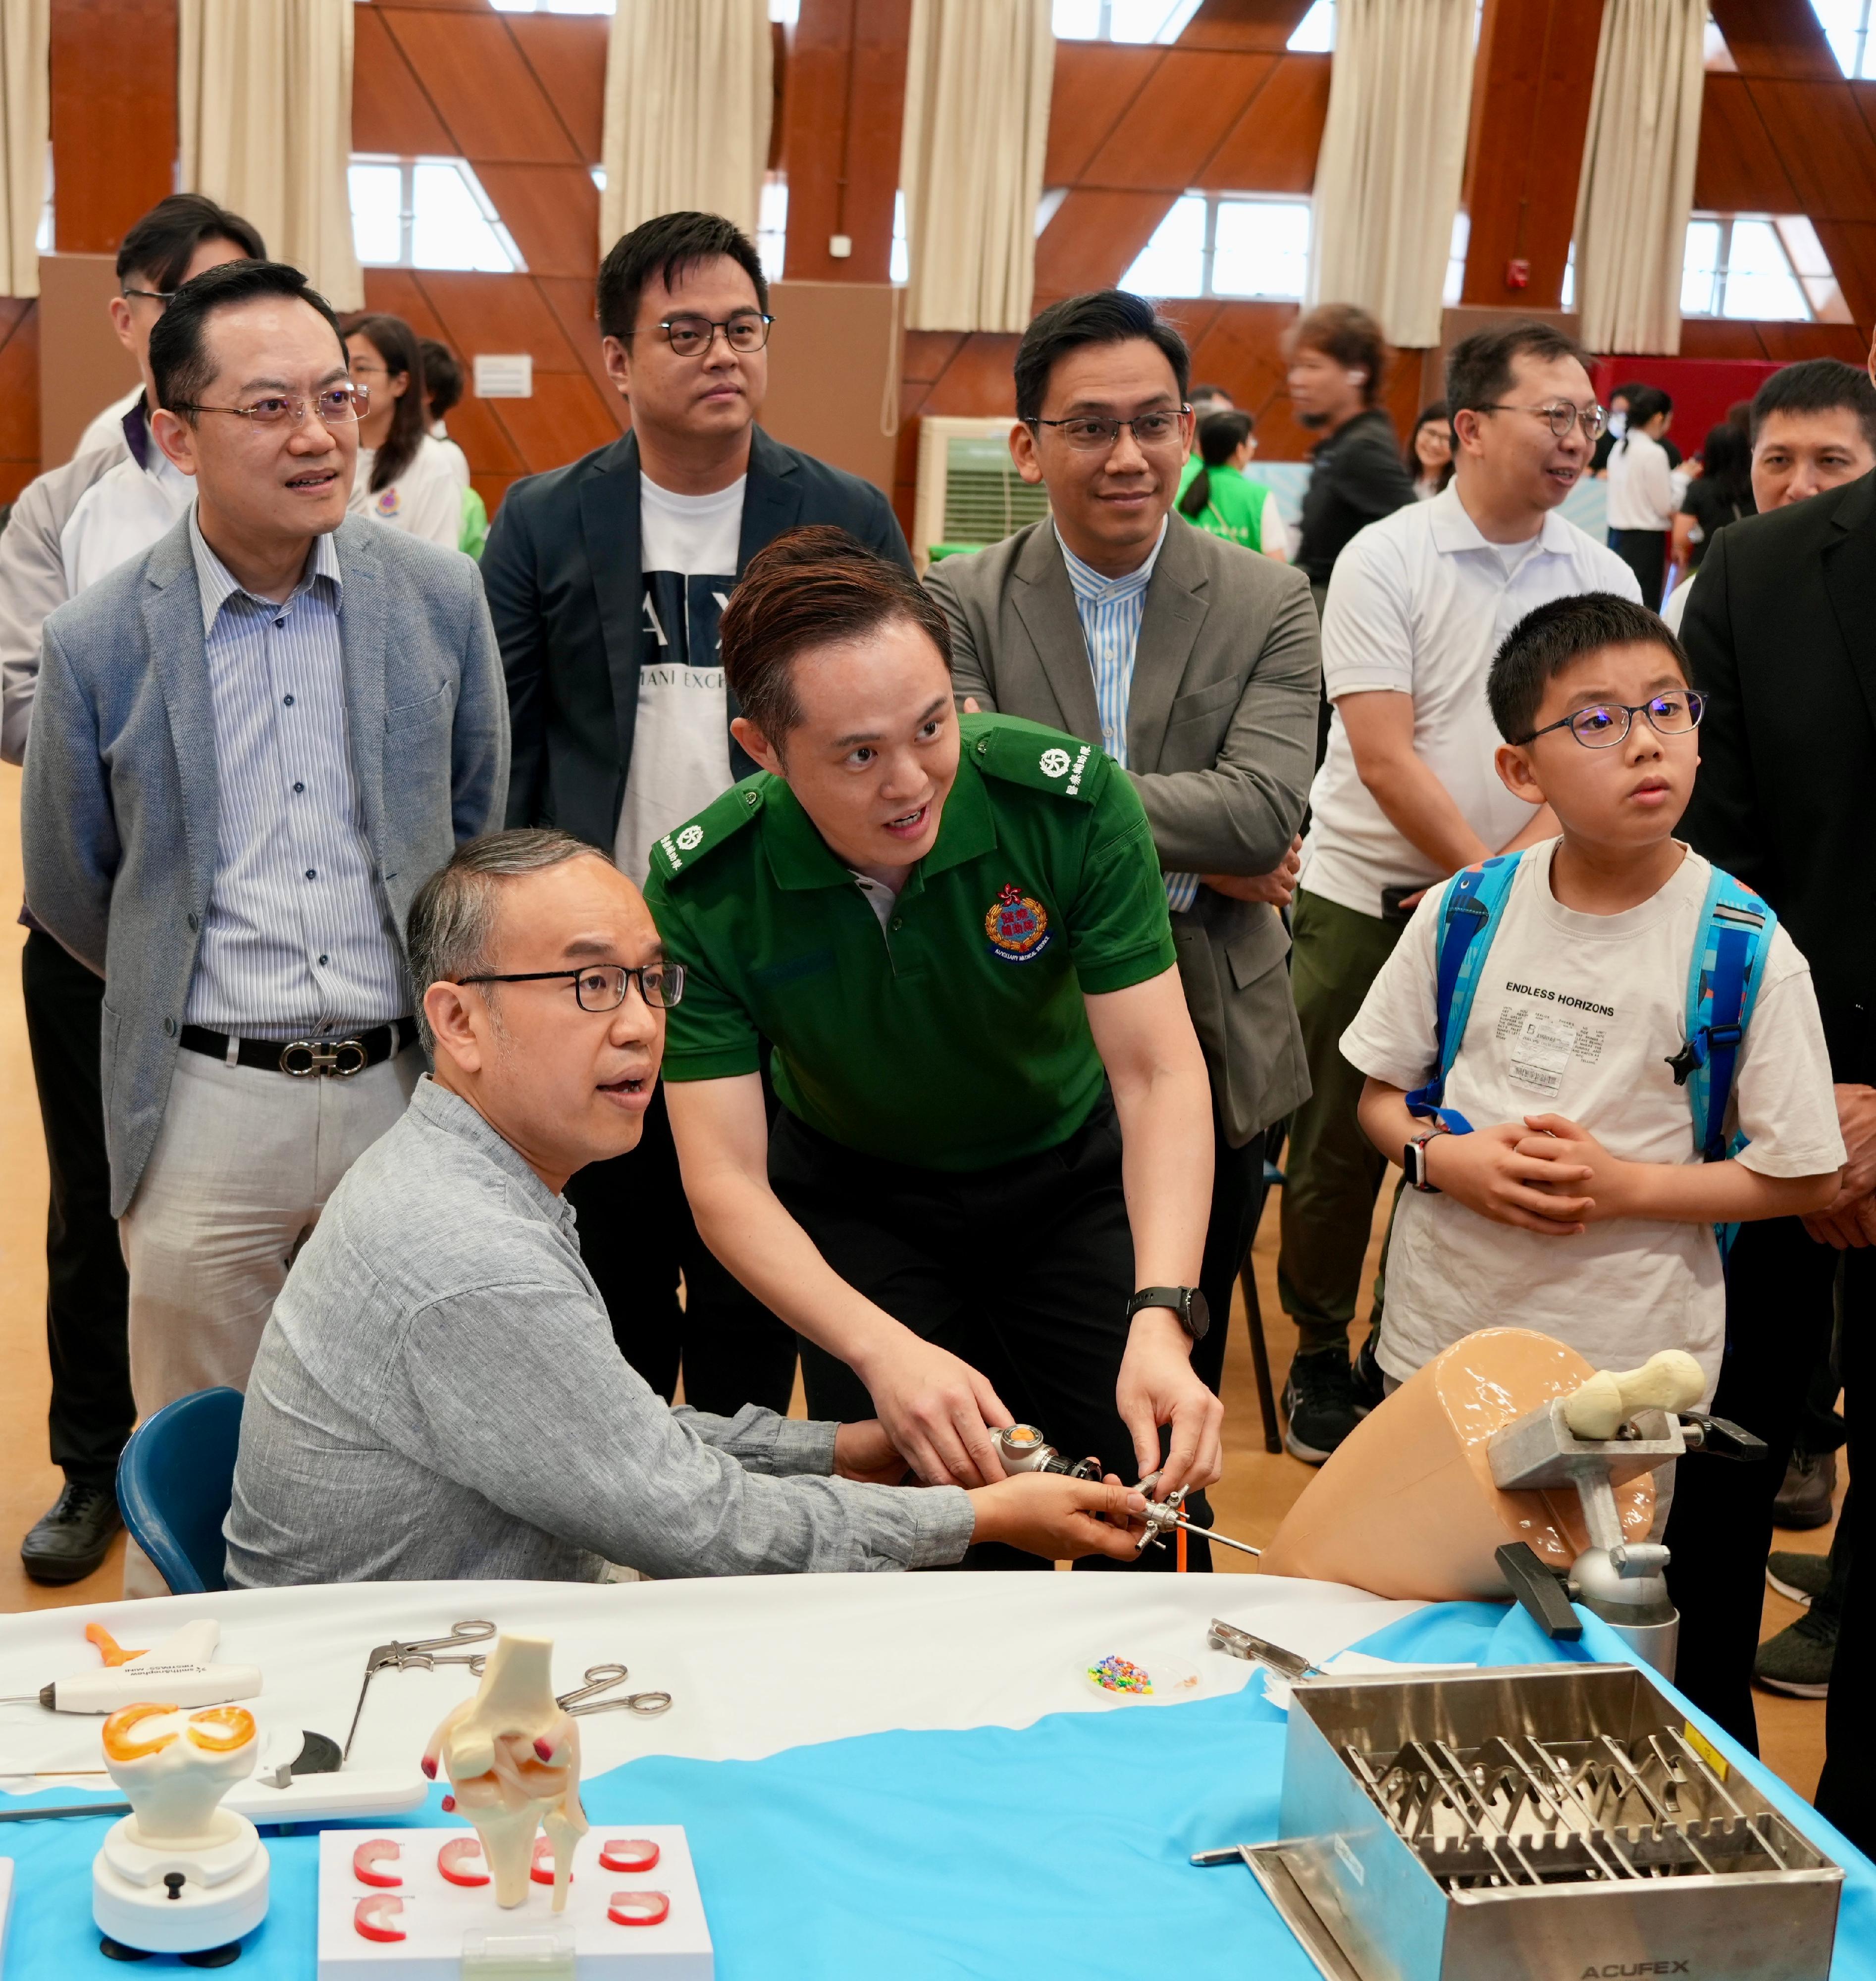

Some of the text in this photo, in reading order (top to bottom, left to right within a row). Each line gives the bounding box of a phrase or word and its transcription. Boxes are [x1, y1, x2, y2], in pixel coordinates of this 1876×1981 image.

[994, 936, 1050, 962] AUXILIARY MEDICAL SERVICE
[1506, 981, 1615, 1017] ENDLESS HORIZONS
[1580, 1959, 1690, 1980] ACUFEX
